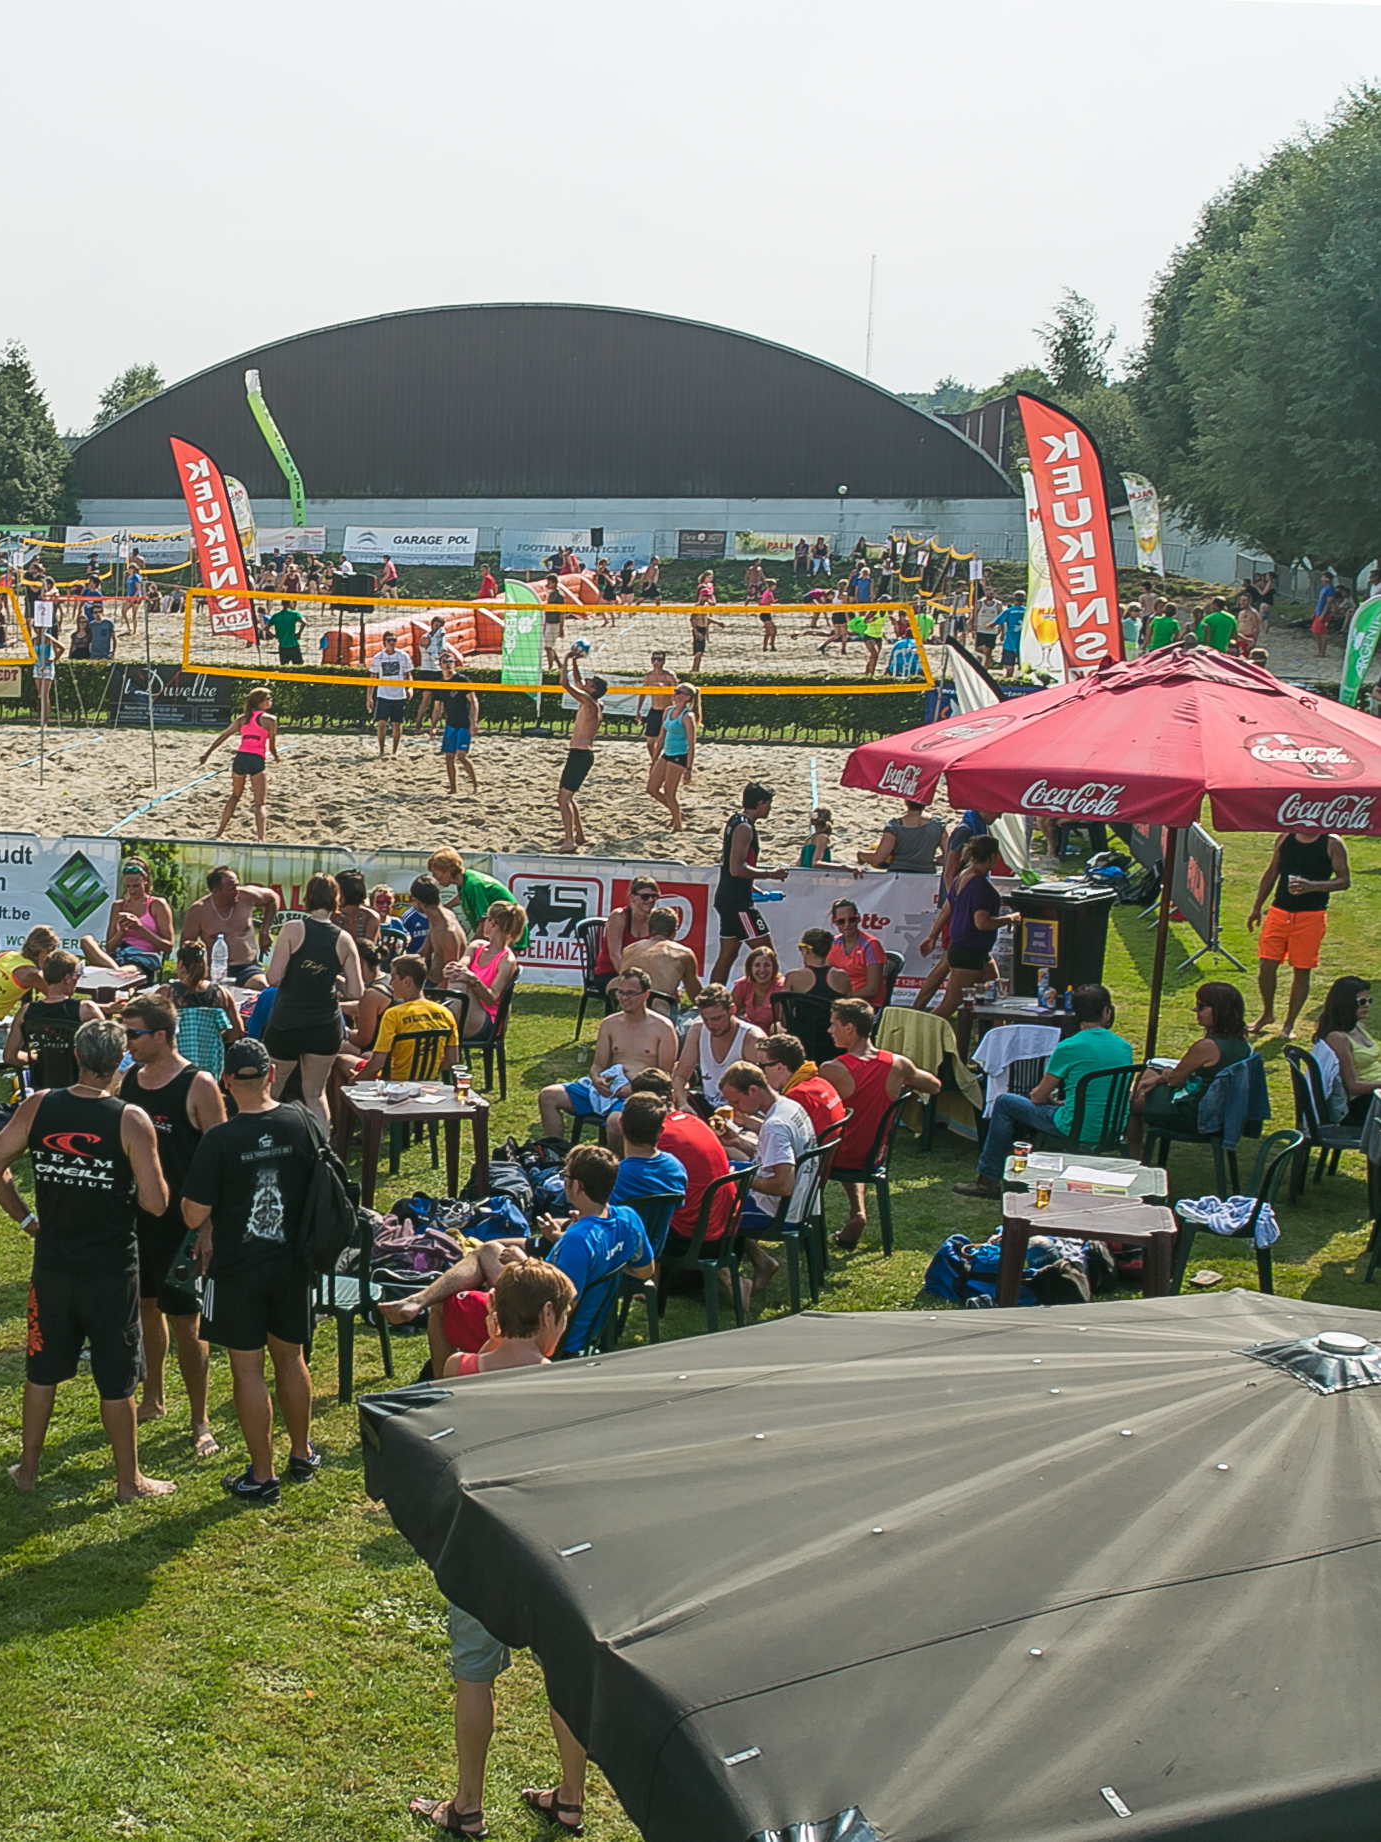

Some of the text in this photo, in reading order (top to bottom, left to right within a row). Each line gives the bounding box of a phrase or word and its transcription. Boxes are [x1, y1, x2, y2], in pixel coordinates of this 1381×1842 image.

[393, 535, 471, 545] GARAGE POL
[767, 541, 794, 550] PALM
[878, 760, 922, 797] Coca-Cola
[1020, 779, 1127, 817] Coca-Cola
[1277, 792, 1377, 830] Coca-Cola
[756, 919, 765, 930] 8
[32, 1150, 115, 1169] TEAM
[36, 1174, 113, 1190] BELGIUM
